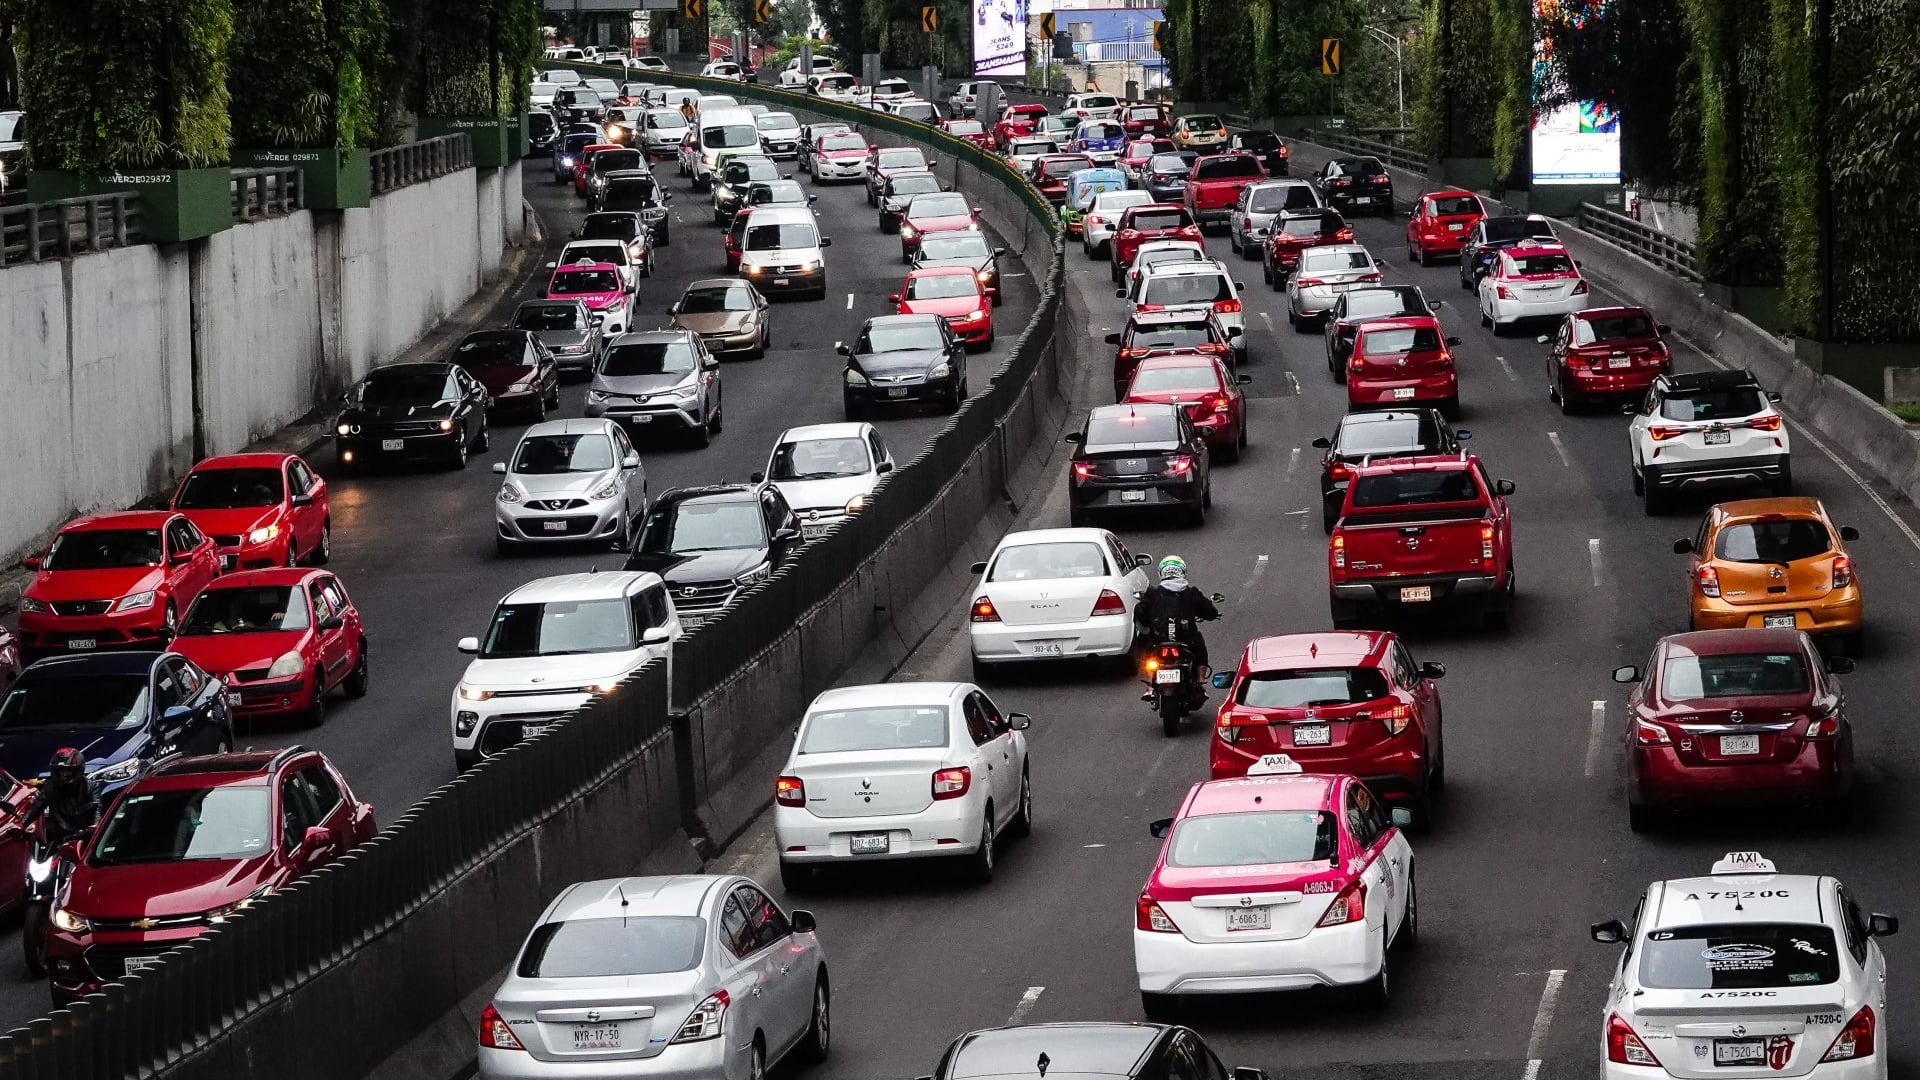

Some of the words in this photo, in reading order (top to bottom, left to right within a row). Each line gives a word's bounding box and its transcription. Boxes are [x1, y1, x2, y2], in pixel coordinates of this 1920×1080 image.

[253, 153, 290, 162] VIAVERDE
[293, 153, 320, 161] 029871
[1263, 756, 1286, 766] TAXI
[1729, 853, 1757, 864] TAXI
[1303, 881, 1334, 894] A-6063-J
[1229, 914, 1268, 924] A-6063-J
[1700, 991, 1777, 999] A7520C
[1805, 1014, 1842, 1025] A-7520-C
[574, 1029, 619, 1042] NYR-17-50
[1718, 1046, 1762, 1059] A-7520-C
